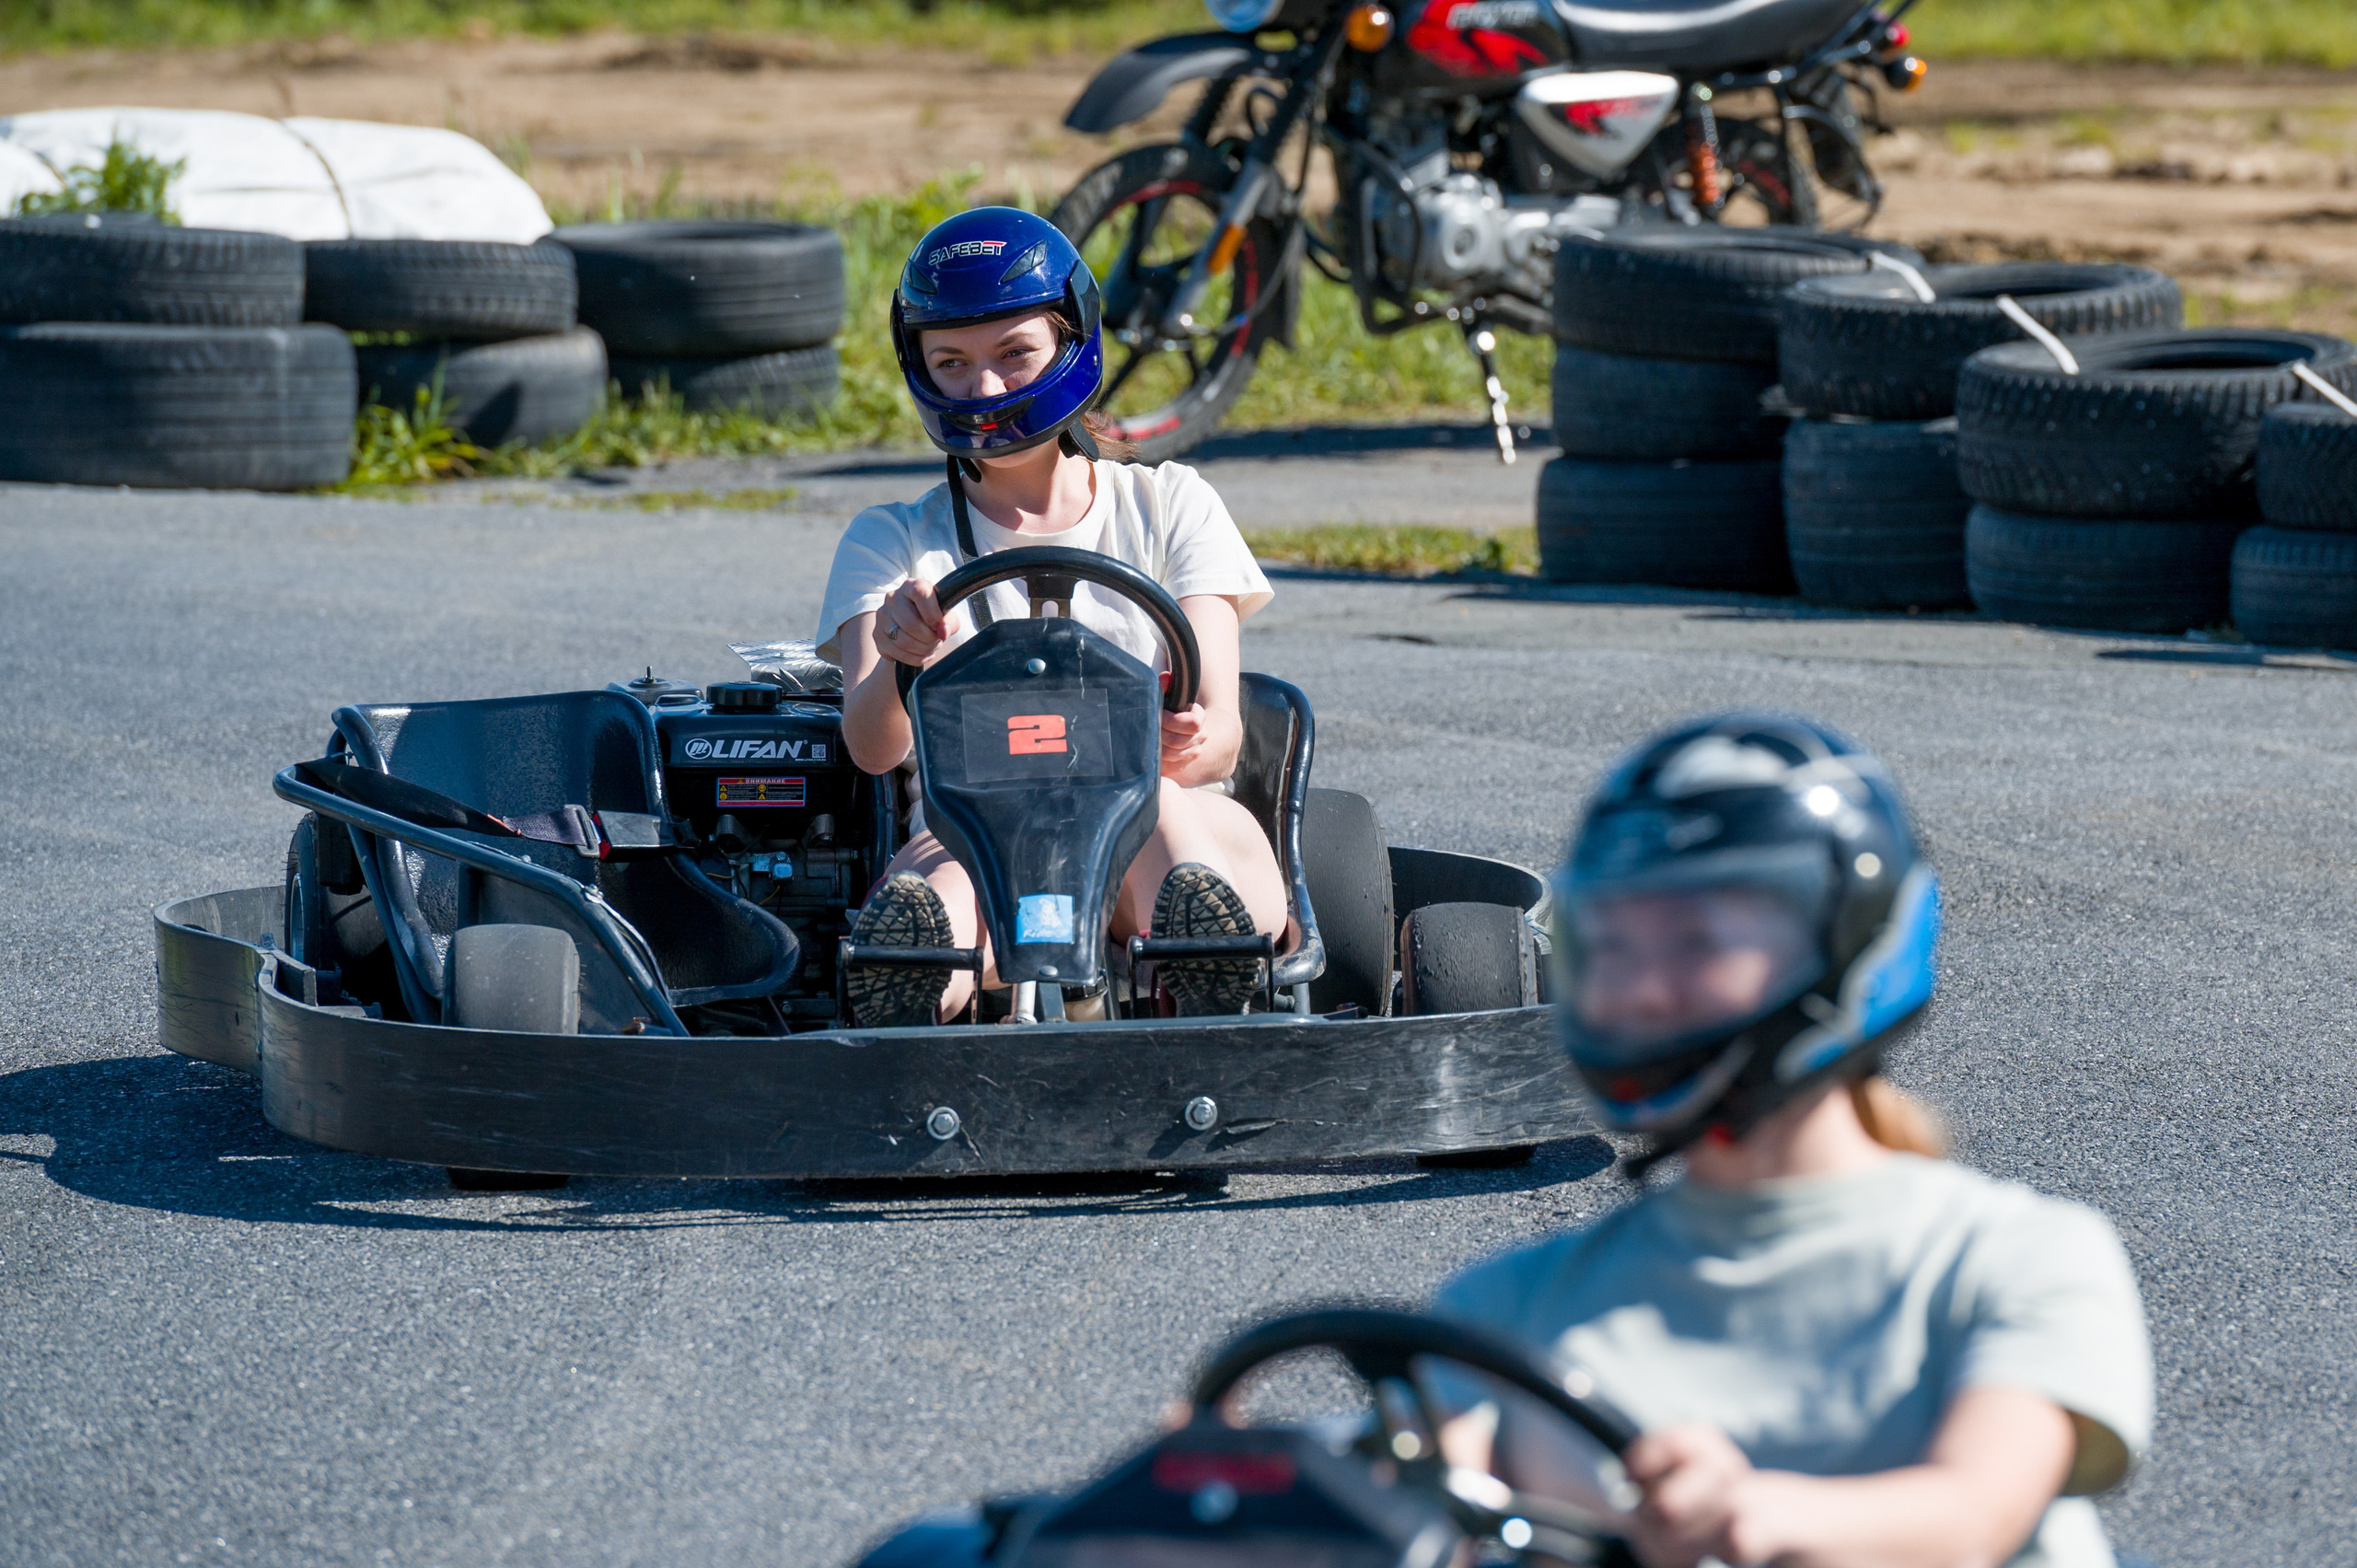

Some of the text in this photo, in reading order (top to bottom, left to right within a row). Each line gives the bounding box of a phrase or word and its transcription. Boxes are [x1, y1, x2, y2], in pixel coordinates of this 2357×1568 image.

[928, 240, 1008, 266] SAFEBET
[1006, 714, 1068, 755] 2
[712, 739, 804, 759] LIFAN
